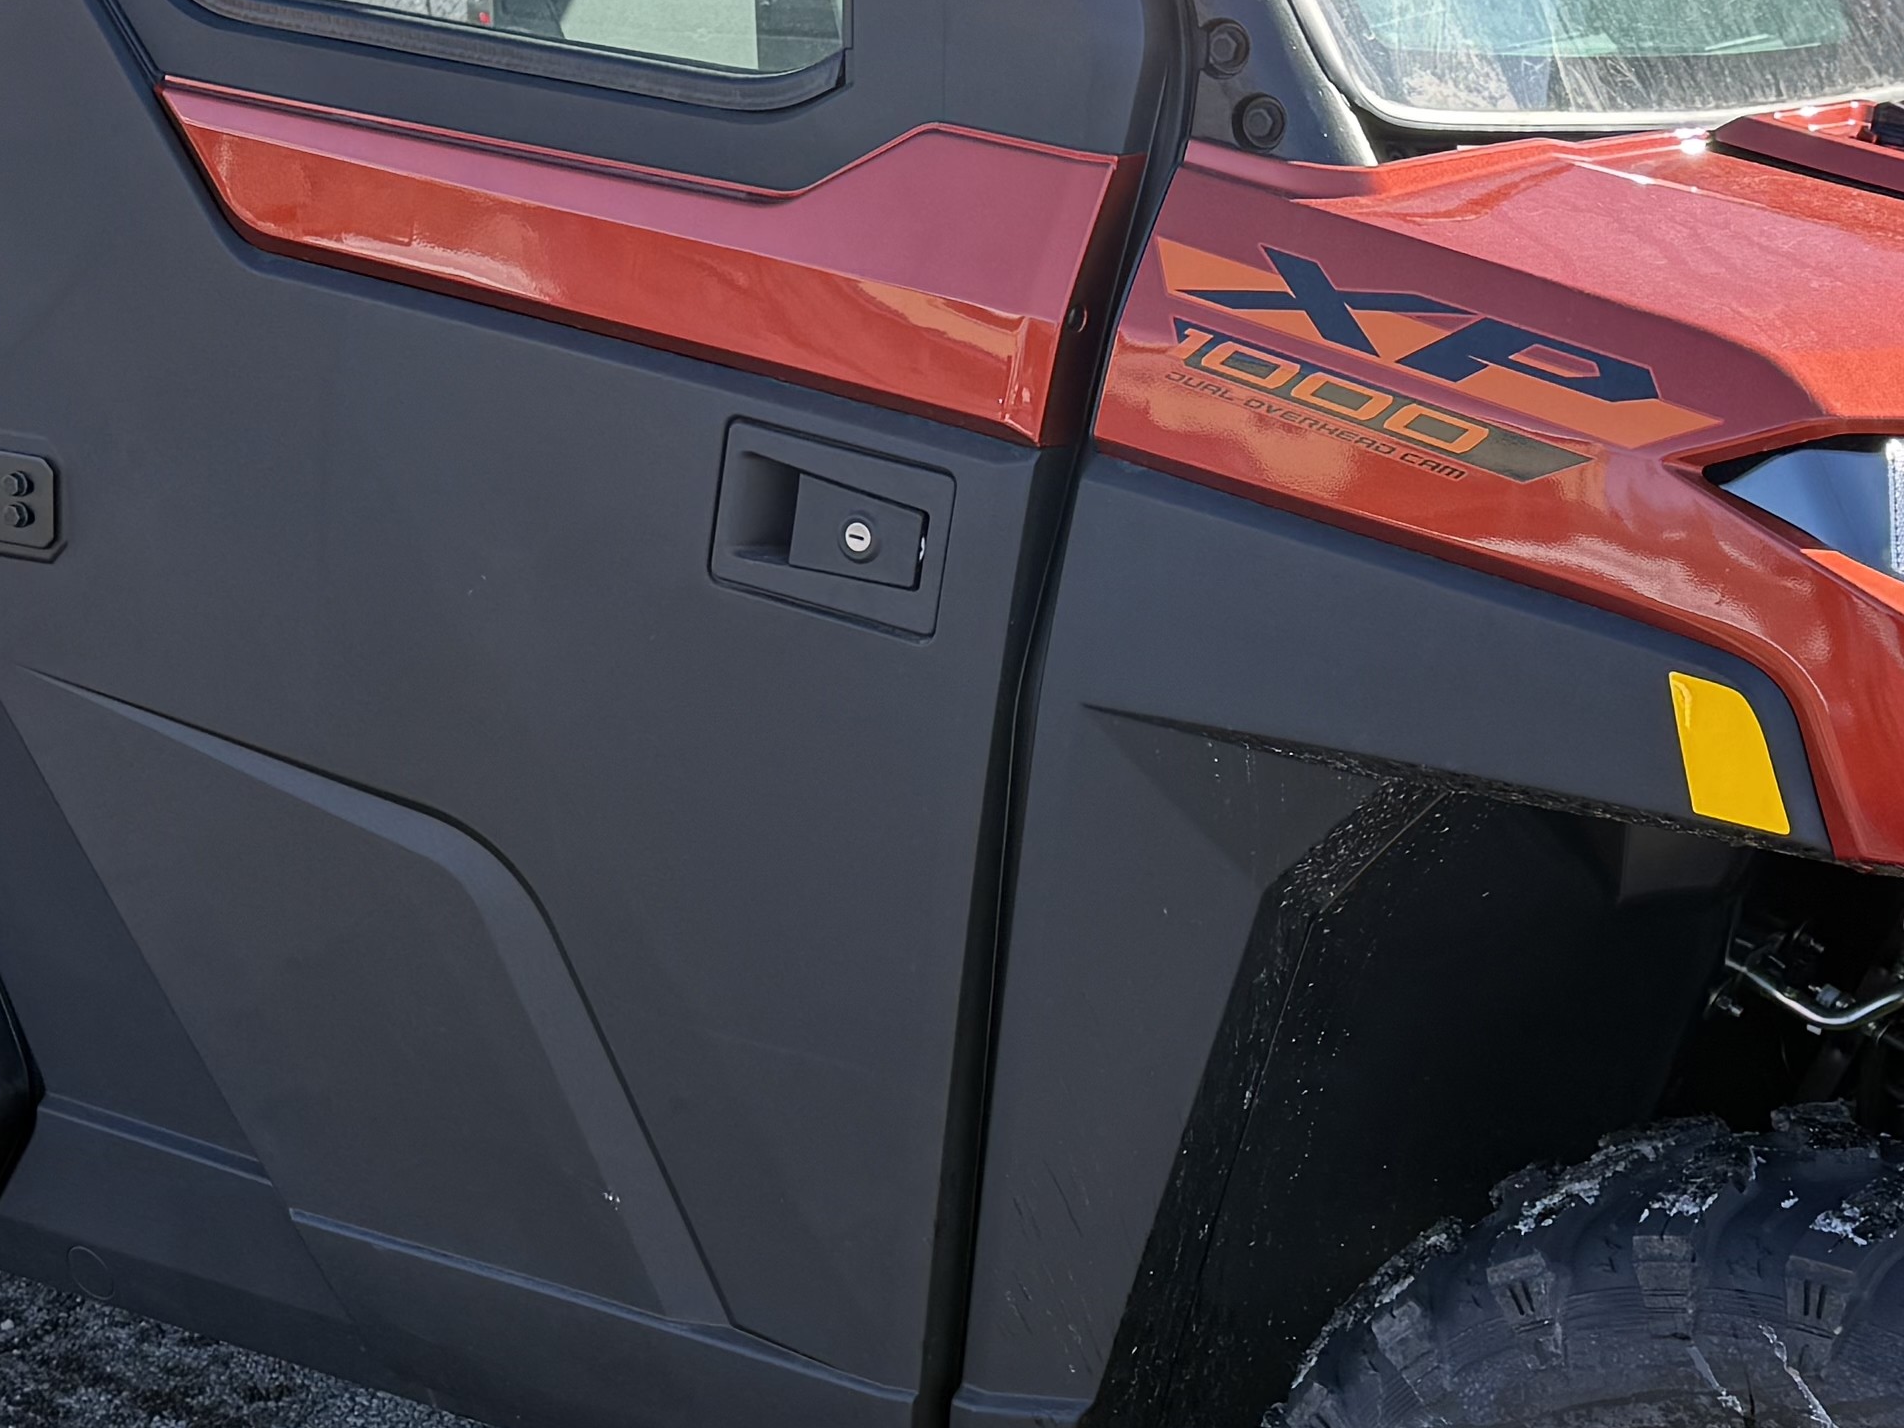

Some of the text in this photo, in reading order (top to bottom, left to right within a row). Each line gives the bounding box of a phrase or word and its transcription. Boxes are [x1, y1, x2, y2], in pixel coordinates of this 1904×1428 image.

[1171, 243, 1661, 403] XP
[1165, 370, 1467, 480] DUAL OVERHEAD CAM
[1166, 327, 1490, 455] 1000
